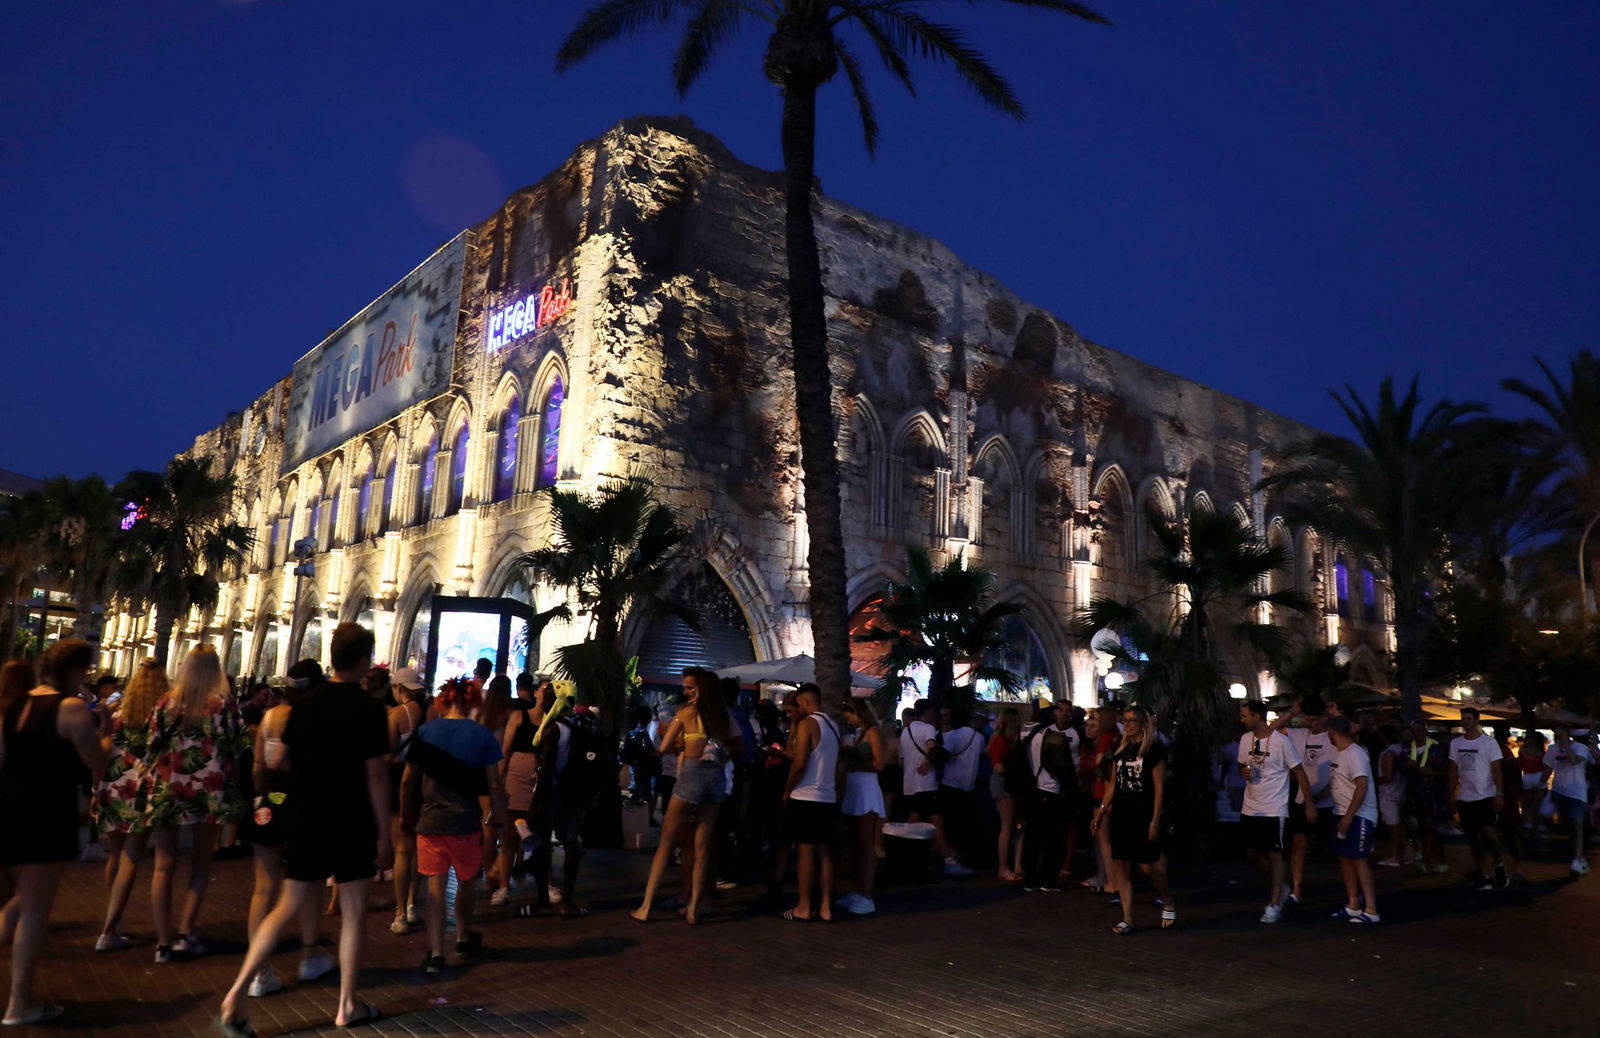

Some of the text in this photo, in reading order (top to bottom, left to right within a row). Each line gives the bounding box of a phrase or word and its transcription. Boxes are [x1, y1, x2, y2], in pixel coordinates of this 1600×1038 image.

[487, 278, 572, 353] MEGA Park
[308, 312, 420, 432] MEGA Park
